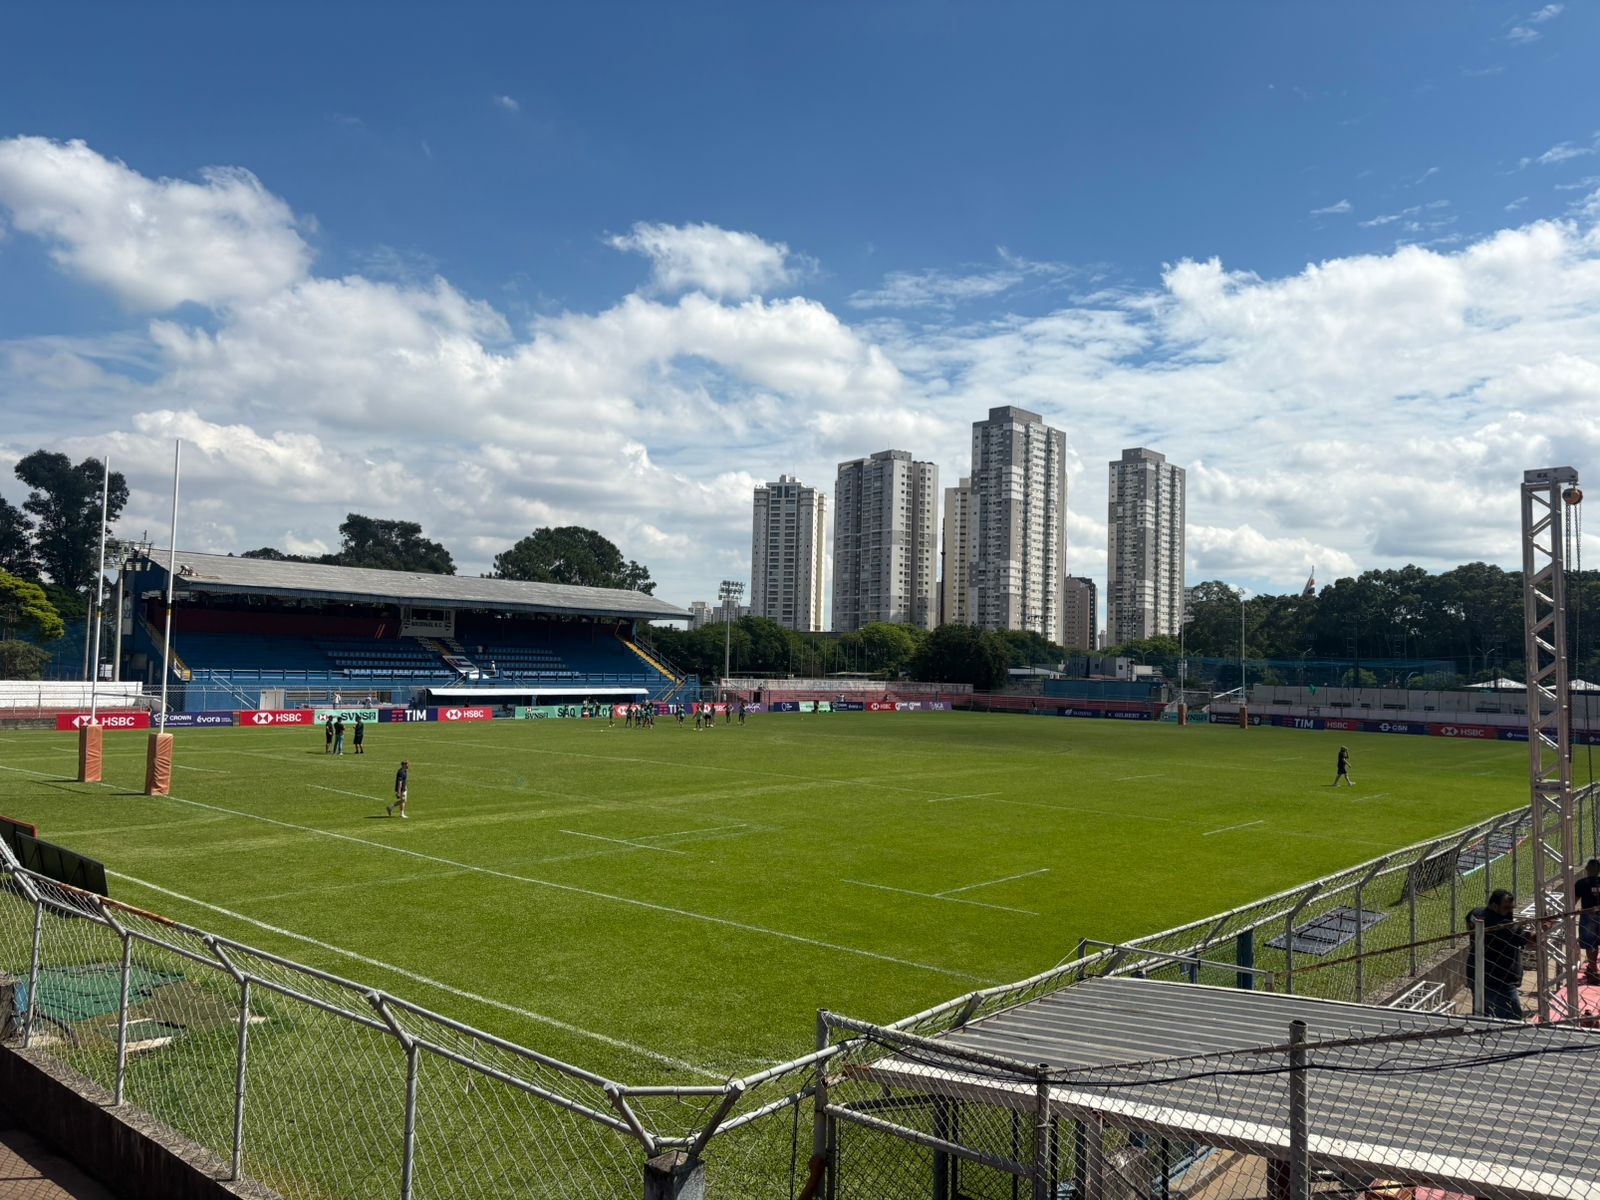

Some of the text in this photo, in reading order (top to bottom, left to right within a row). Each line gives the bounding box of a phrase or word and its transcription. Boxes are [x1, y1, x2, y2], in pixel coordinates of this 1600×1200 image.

[275, 713, 302, 722] HSBC
[405, 709, 427, 721] TIM
[463, 710, 484, 718] HSBC
[101, 716, 135, 727] HSBC
[196, 715, 221, 723] évora
[1294, 718, 1314, 729] TIM
[1326, 721, 1349, 729] HSBC
[1460, 728, 1485, 737] HSBC
